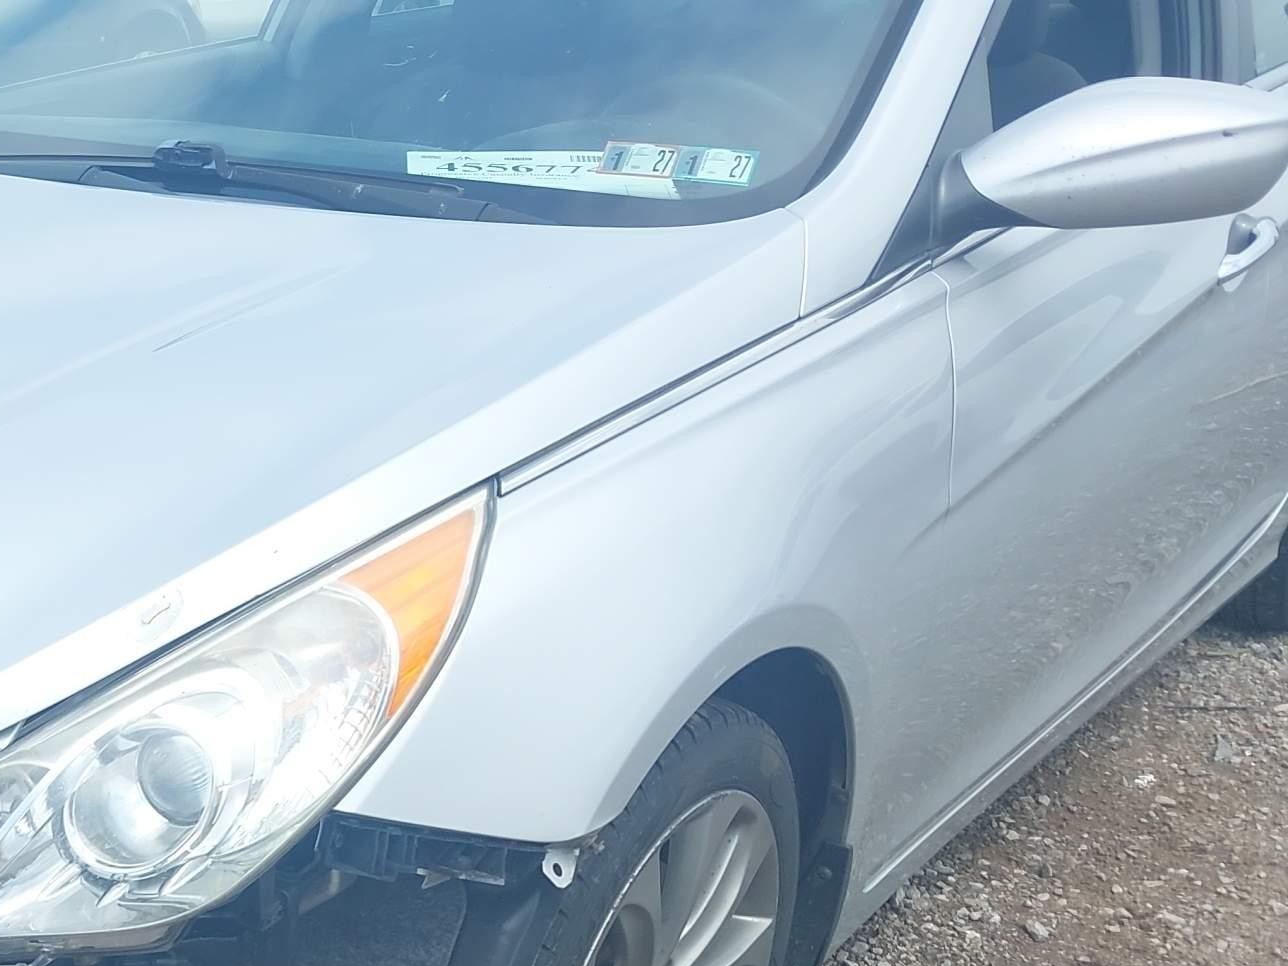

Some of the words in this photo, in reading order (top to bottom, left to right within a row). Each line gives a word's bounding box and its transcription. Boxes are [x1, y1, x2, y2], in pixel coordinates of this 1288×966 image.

[436, 162, 599, 173] 455677
[652, 149, 675, 174] 27
[728, 155, 752, 179] 27
